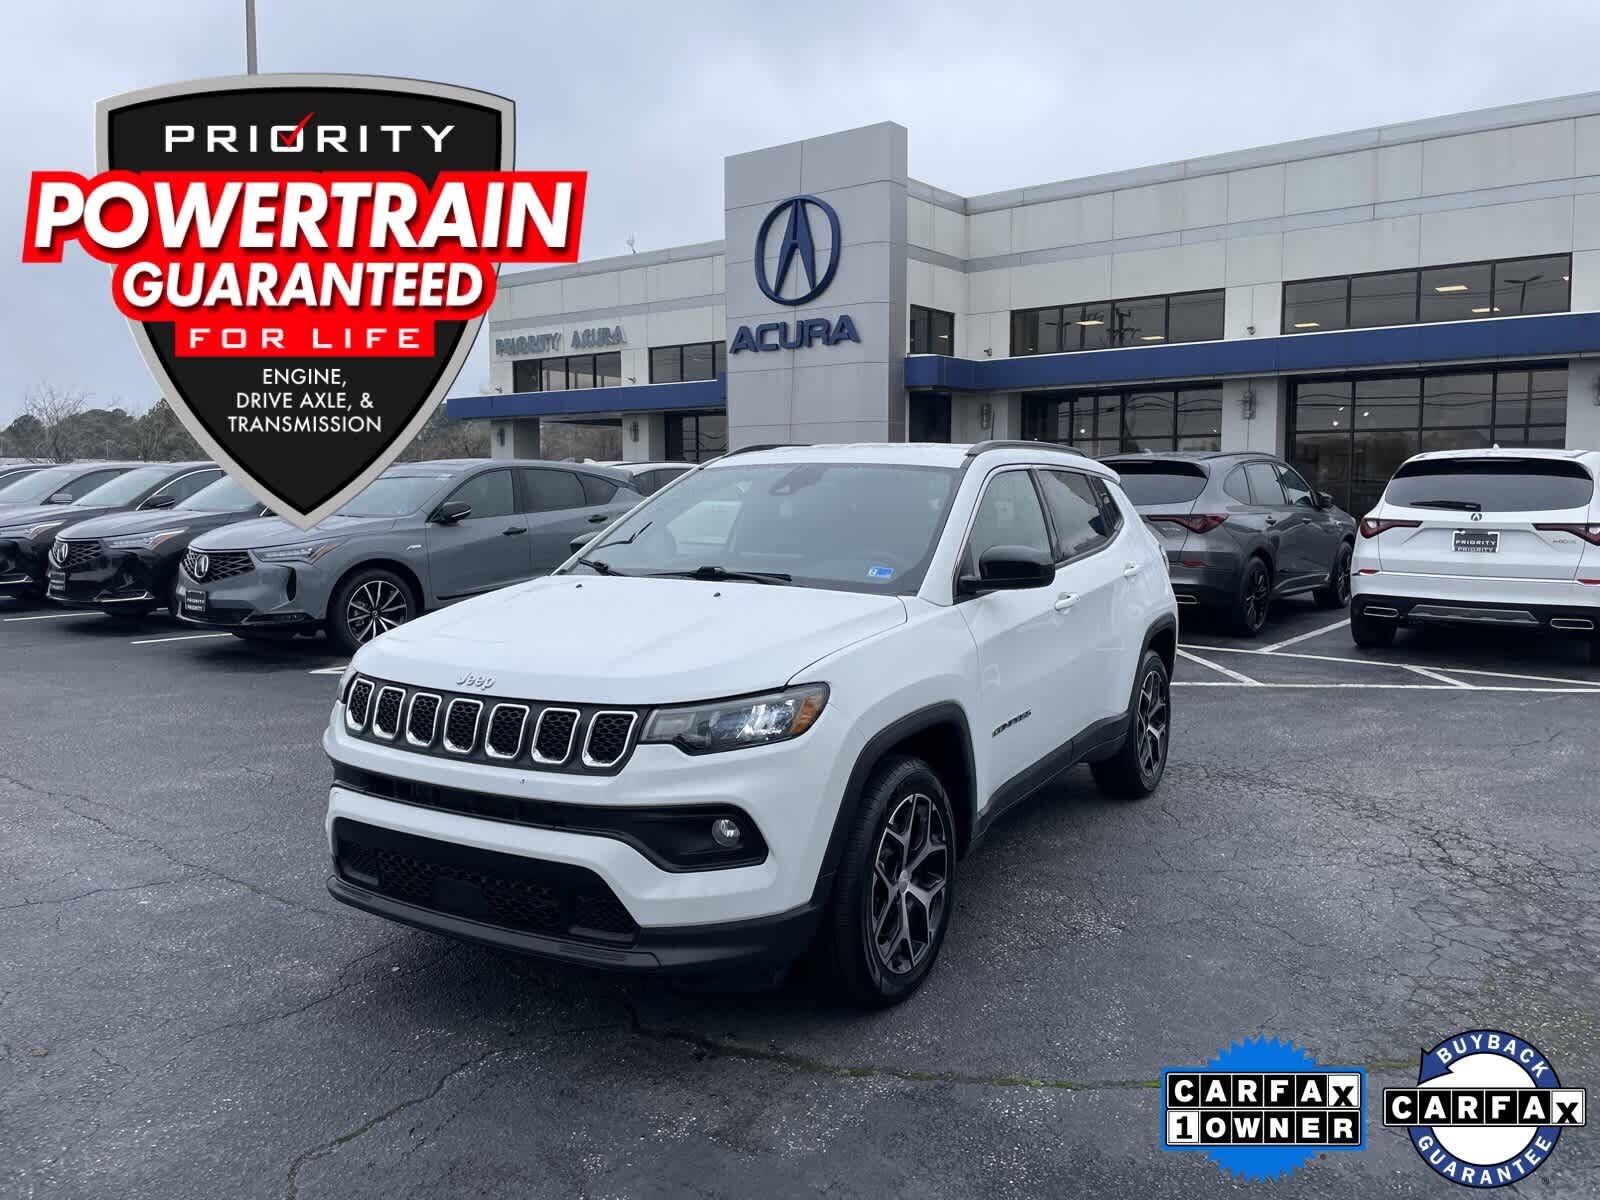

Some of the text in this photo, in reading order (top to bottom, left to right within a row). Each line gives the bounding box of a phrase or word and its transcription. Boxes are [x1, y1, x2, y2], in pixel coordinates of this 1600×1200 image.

[495, 324, 627, 356] PRIORITY ACURA
[729, 315, 862, 354] ACURA
[456, 671, 495, 691] Jeep
